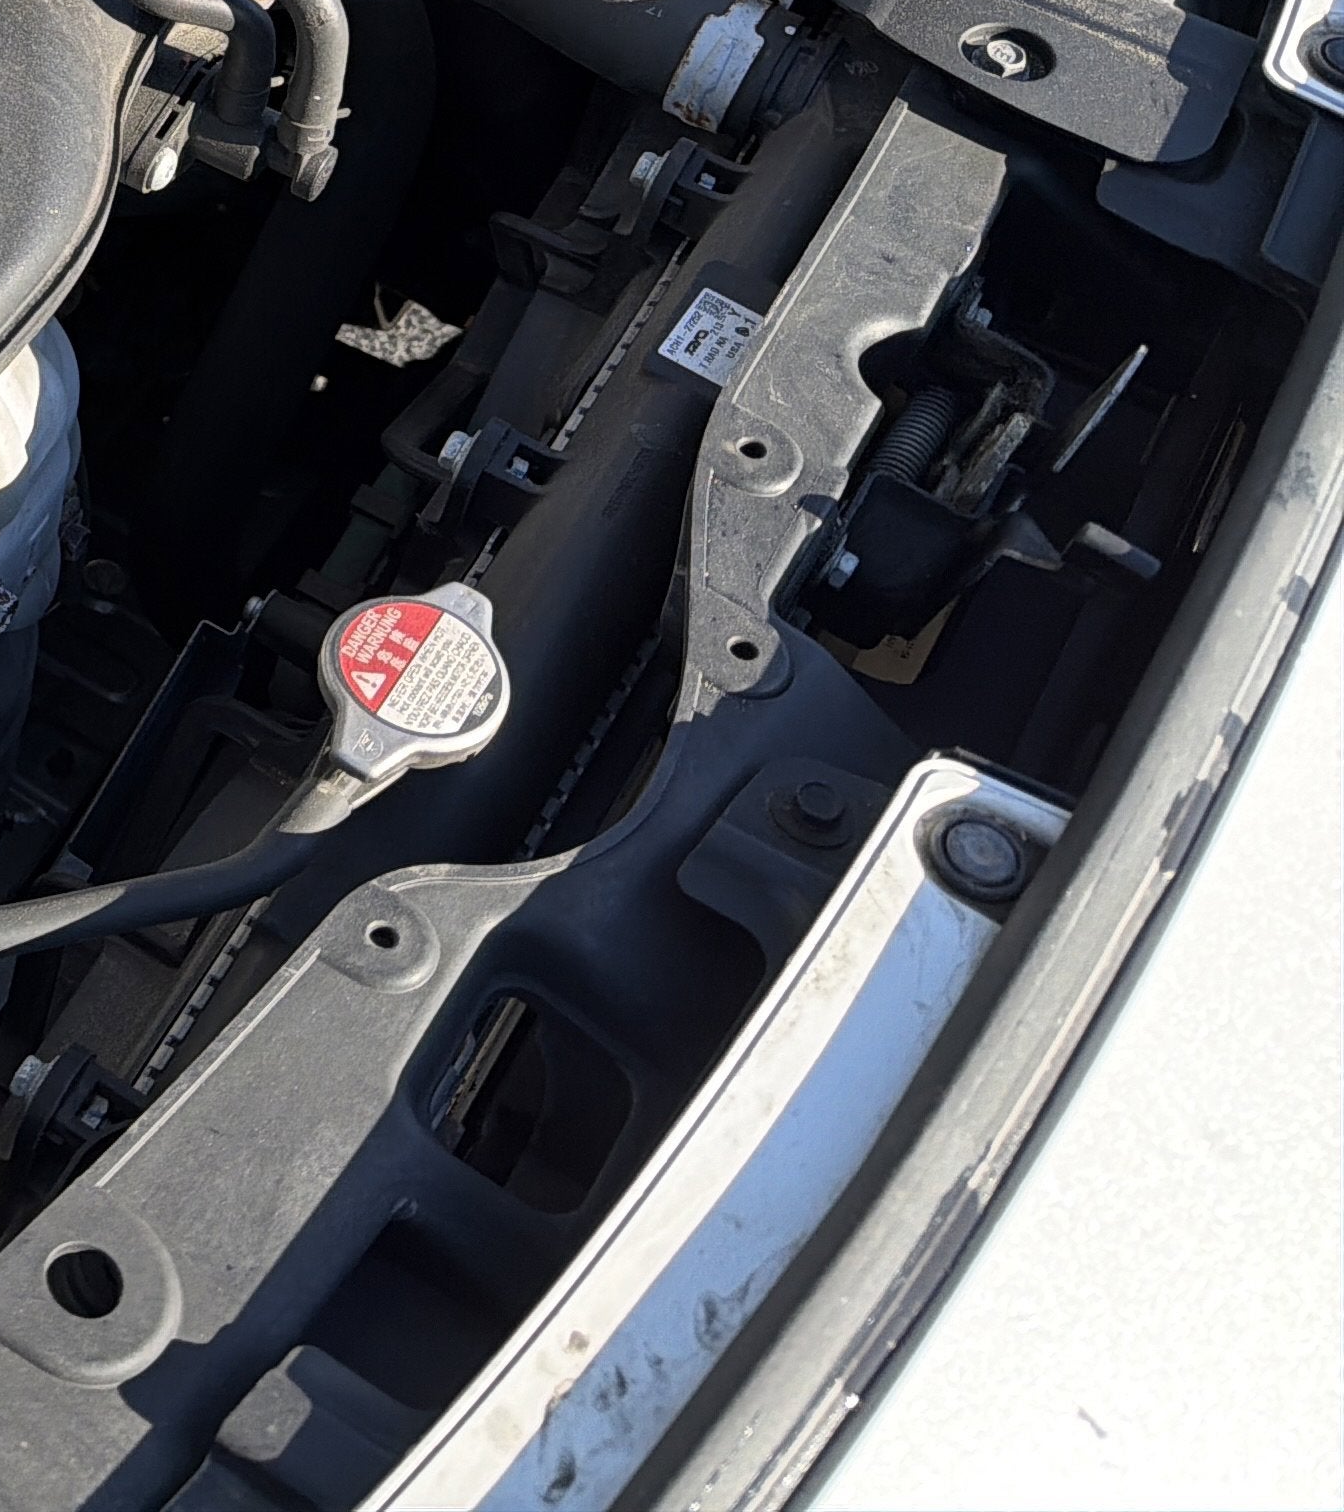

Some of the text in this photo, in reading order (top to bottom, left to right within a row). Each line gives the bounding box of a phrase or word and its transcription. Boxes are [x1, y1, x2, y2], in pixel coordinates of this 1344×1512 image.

[725, 341, 744, 359] USA
[340, 609, 381, 657] DANGER
[357, 606, 402, 664] WARNUNG
[403, 660, 422, 684] OPEN
